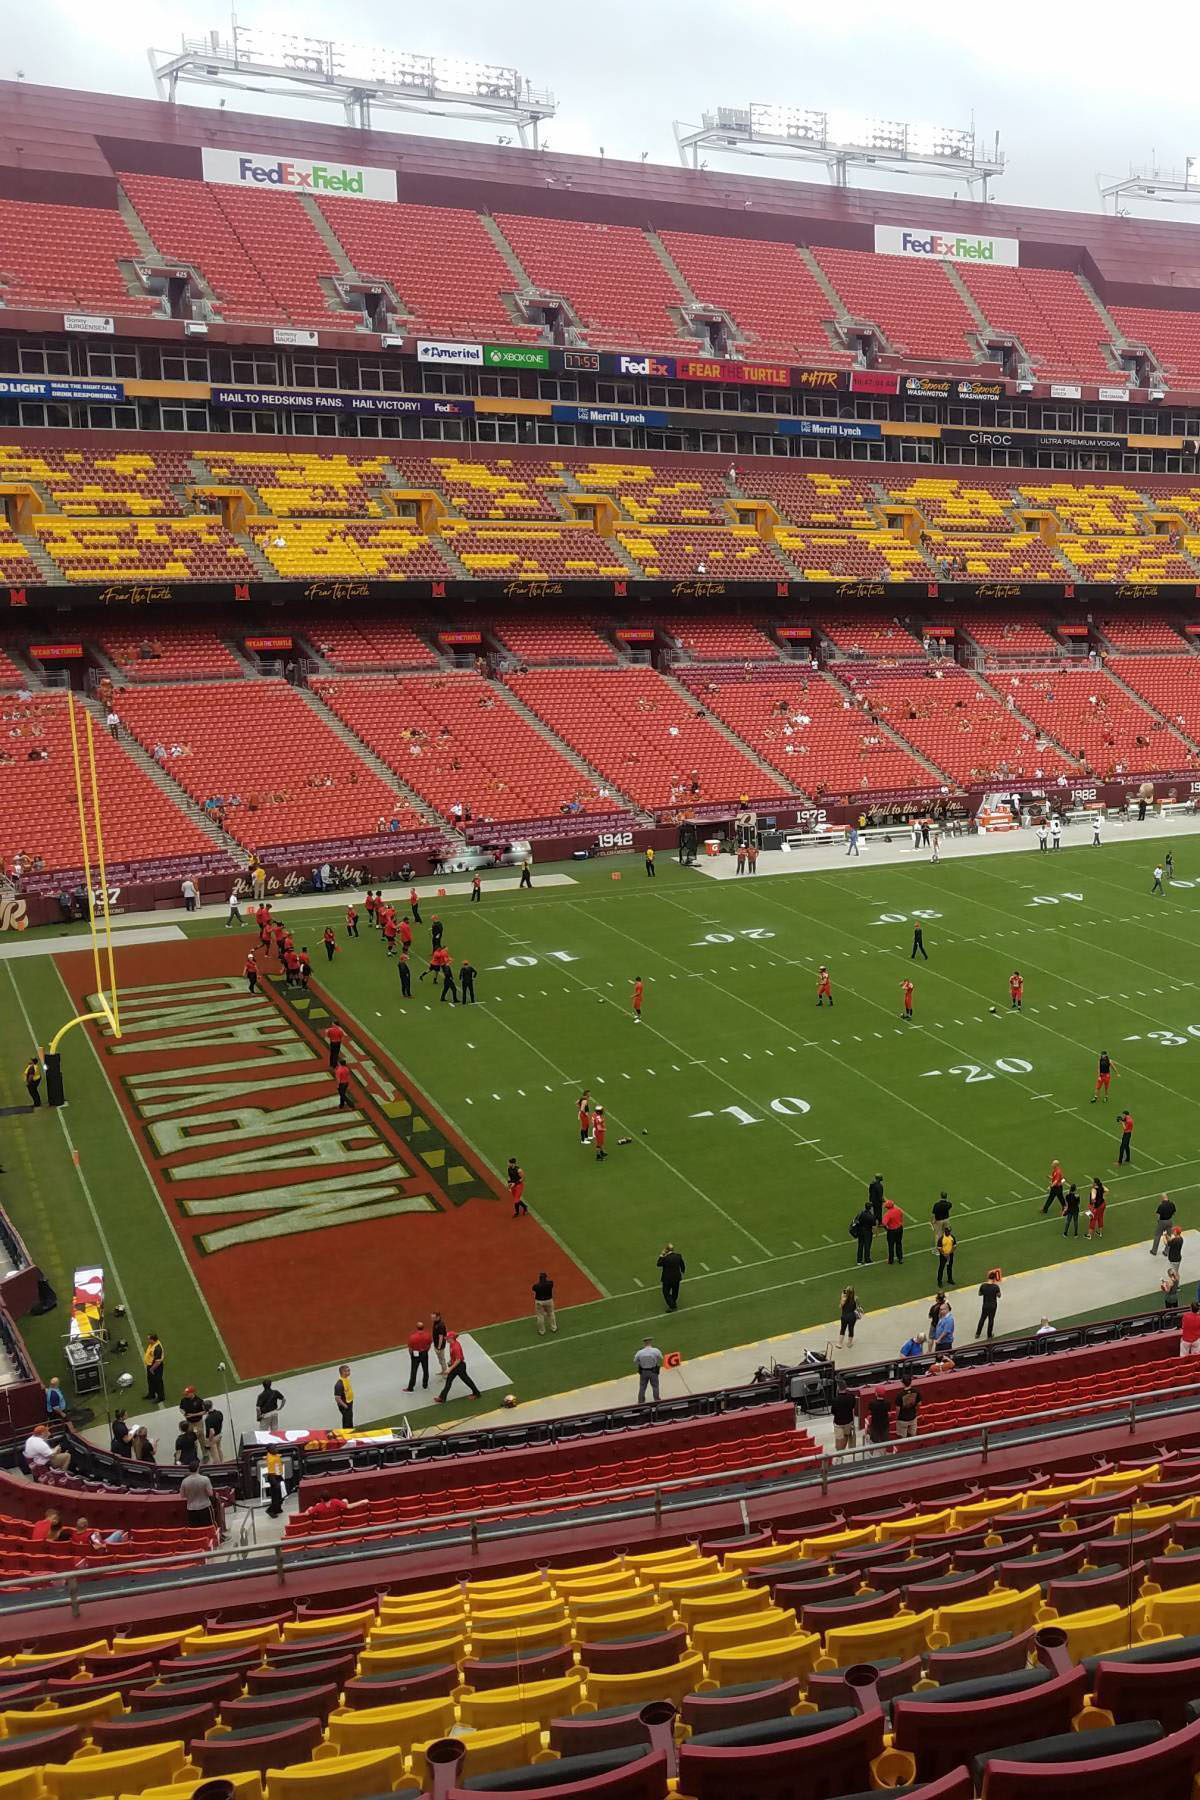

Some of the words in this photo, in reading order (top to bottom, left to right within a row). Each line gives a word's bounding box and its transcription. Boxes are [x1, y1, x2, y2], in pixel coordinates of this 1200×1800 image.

[239, 157, 363, 193] FedExField
[902, 232, 993, 260] FedExField
[175, 271, 188, 279] 425
[430, 346, 480, 360] Ameritel
[502, 352, 526, 362] XBOX
[526, 353, 544, 363] ONE
[620, 356, 669, 376] FedEx
[800, 370, 839, 390] #HTTR
[920, 378, 950, 391] Sports
[10, 383, 46, 393] LIGHT
[907, 388, 948, 399] WASHINGTON
[971, 382, 1001, 395] Sports
[73, 392, 118, 400] RESPONSIBLY
[219, 392, 244, 403] HAIL
[244, 394, 259, 404] TO
[261, 394, 314, 407] REDSKINS
[315, 397, 344, 408] FANS.
[959, 392, 1000, 402] WASHINGTON
[352, 399, 376, 409] HAIL
[376, 400, 421, 411] VICTORY!
[434, 402, 461, 413] FedEx
[590, 411, 619, 422] Merrill
[620, 412, 645, 424] Lynch
[812, 424, 837, 434] Merrill
[838, 425, 861, 437] Lynch
[1040, 437, 1062, 446] ULTRA
[1063, 438, 1096, 447] PREMIUM
[1097, 439, 1121, 448] VODKA
[1071, 788, 1096, 801] 1982
[902, 802, 918, 814] the
[796, 809, 827, 824] 1972
[597, 832, 633, 848] 1942
[712, 843, 719, 851] G
[267, 876, 282, 890] to
[284, 871, 305, 887] the
[1032, 892, 1087, 905] 40
[878, 908, 944, 924] 30
[703, 926, 776, 945] 20
[505, 950, 580, 967] 10
[947, 1056, 1034, 1084] 20
[85, 974, 443, 1256] MARYLAND
[720, 1095, 812, 1126] 10
[667, 1353, 681, 1368] G
